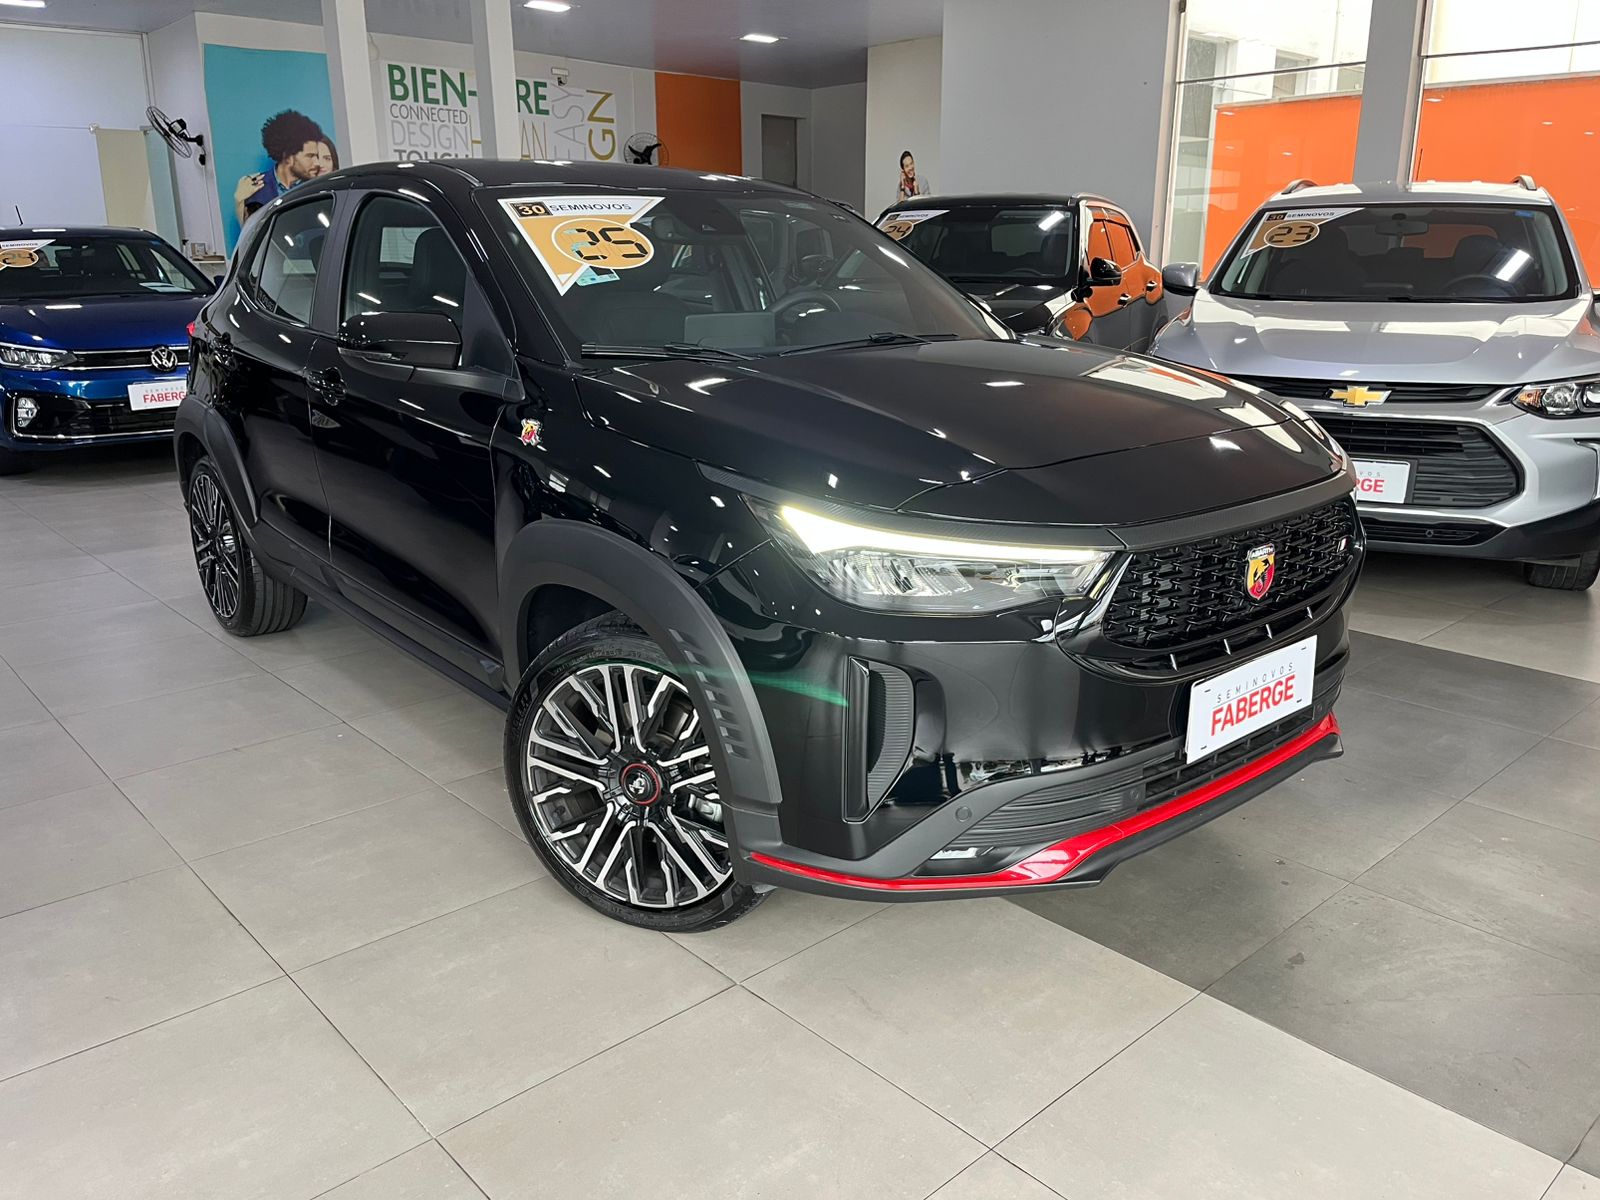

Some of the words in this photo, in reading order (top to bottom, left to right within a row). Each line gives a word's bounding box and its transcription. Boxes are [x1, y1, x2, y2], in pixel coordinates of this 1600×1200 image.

[390, 103, 468, 124] CONNECTED
[391, 120, 469, 151] DESIGN
[519, 205, 546, 215] 30
[550, 203, 632, 212] SEMINOVOS
[1269, 225, 1315, 243] 23
[143, 391, 187, 403] FABERG
[1217, 662, 1294, 703] SEMINOVOS
[1211, 674, 1296, 736] FABERGE
